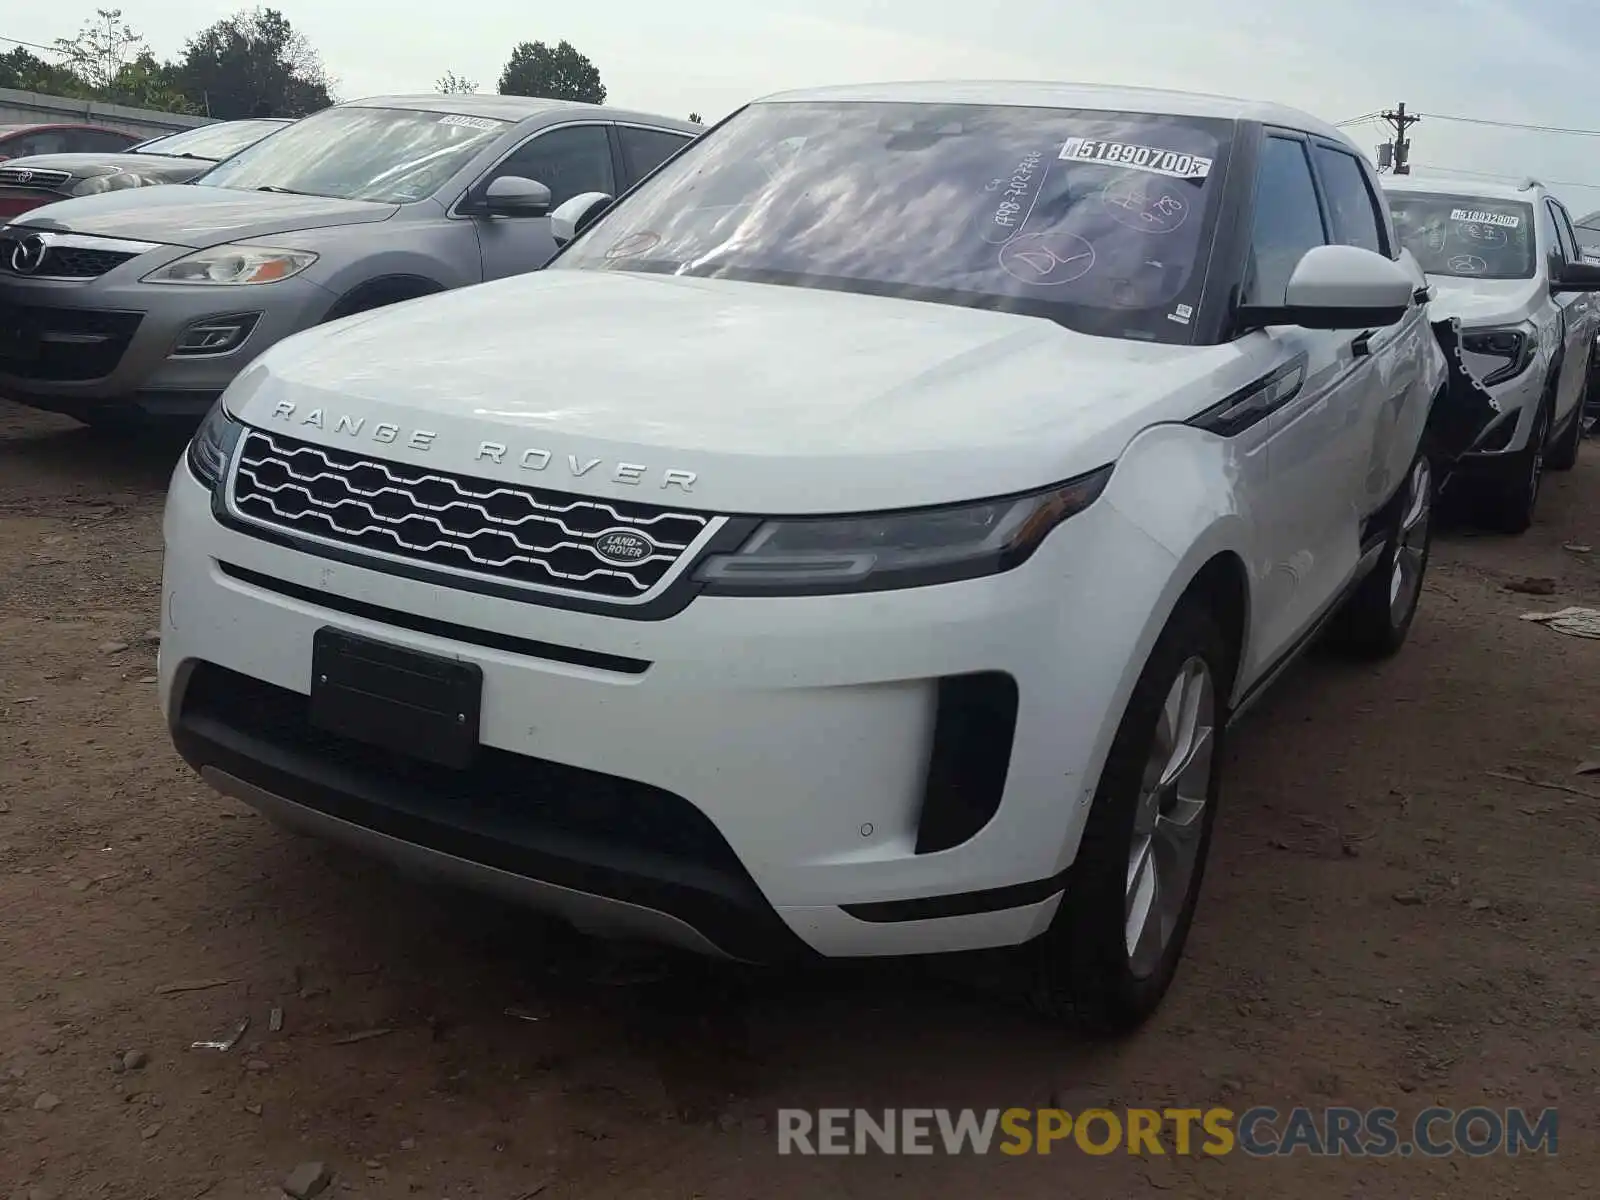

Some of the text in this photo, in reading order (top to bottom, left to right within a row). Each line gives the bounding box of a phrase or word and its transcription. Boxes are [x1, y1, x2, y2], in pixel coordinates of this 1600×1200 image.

[1077, 141, 1191, 175] 51890700
[272, 400, 697, 492] RANGE ROVER
[607, 535, 637, 547] LAND
[607, 545, 643, 558] ROVER
